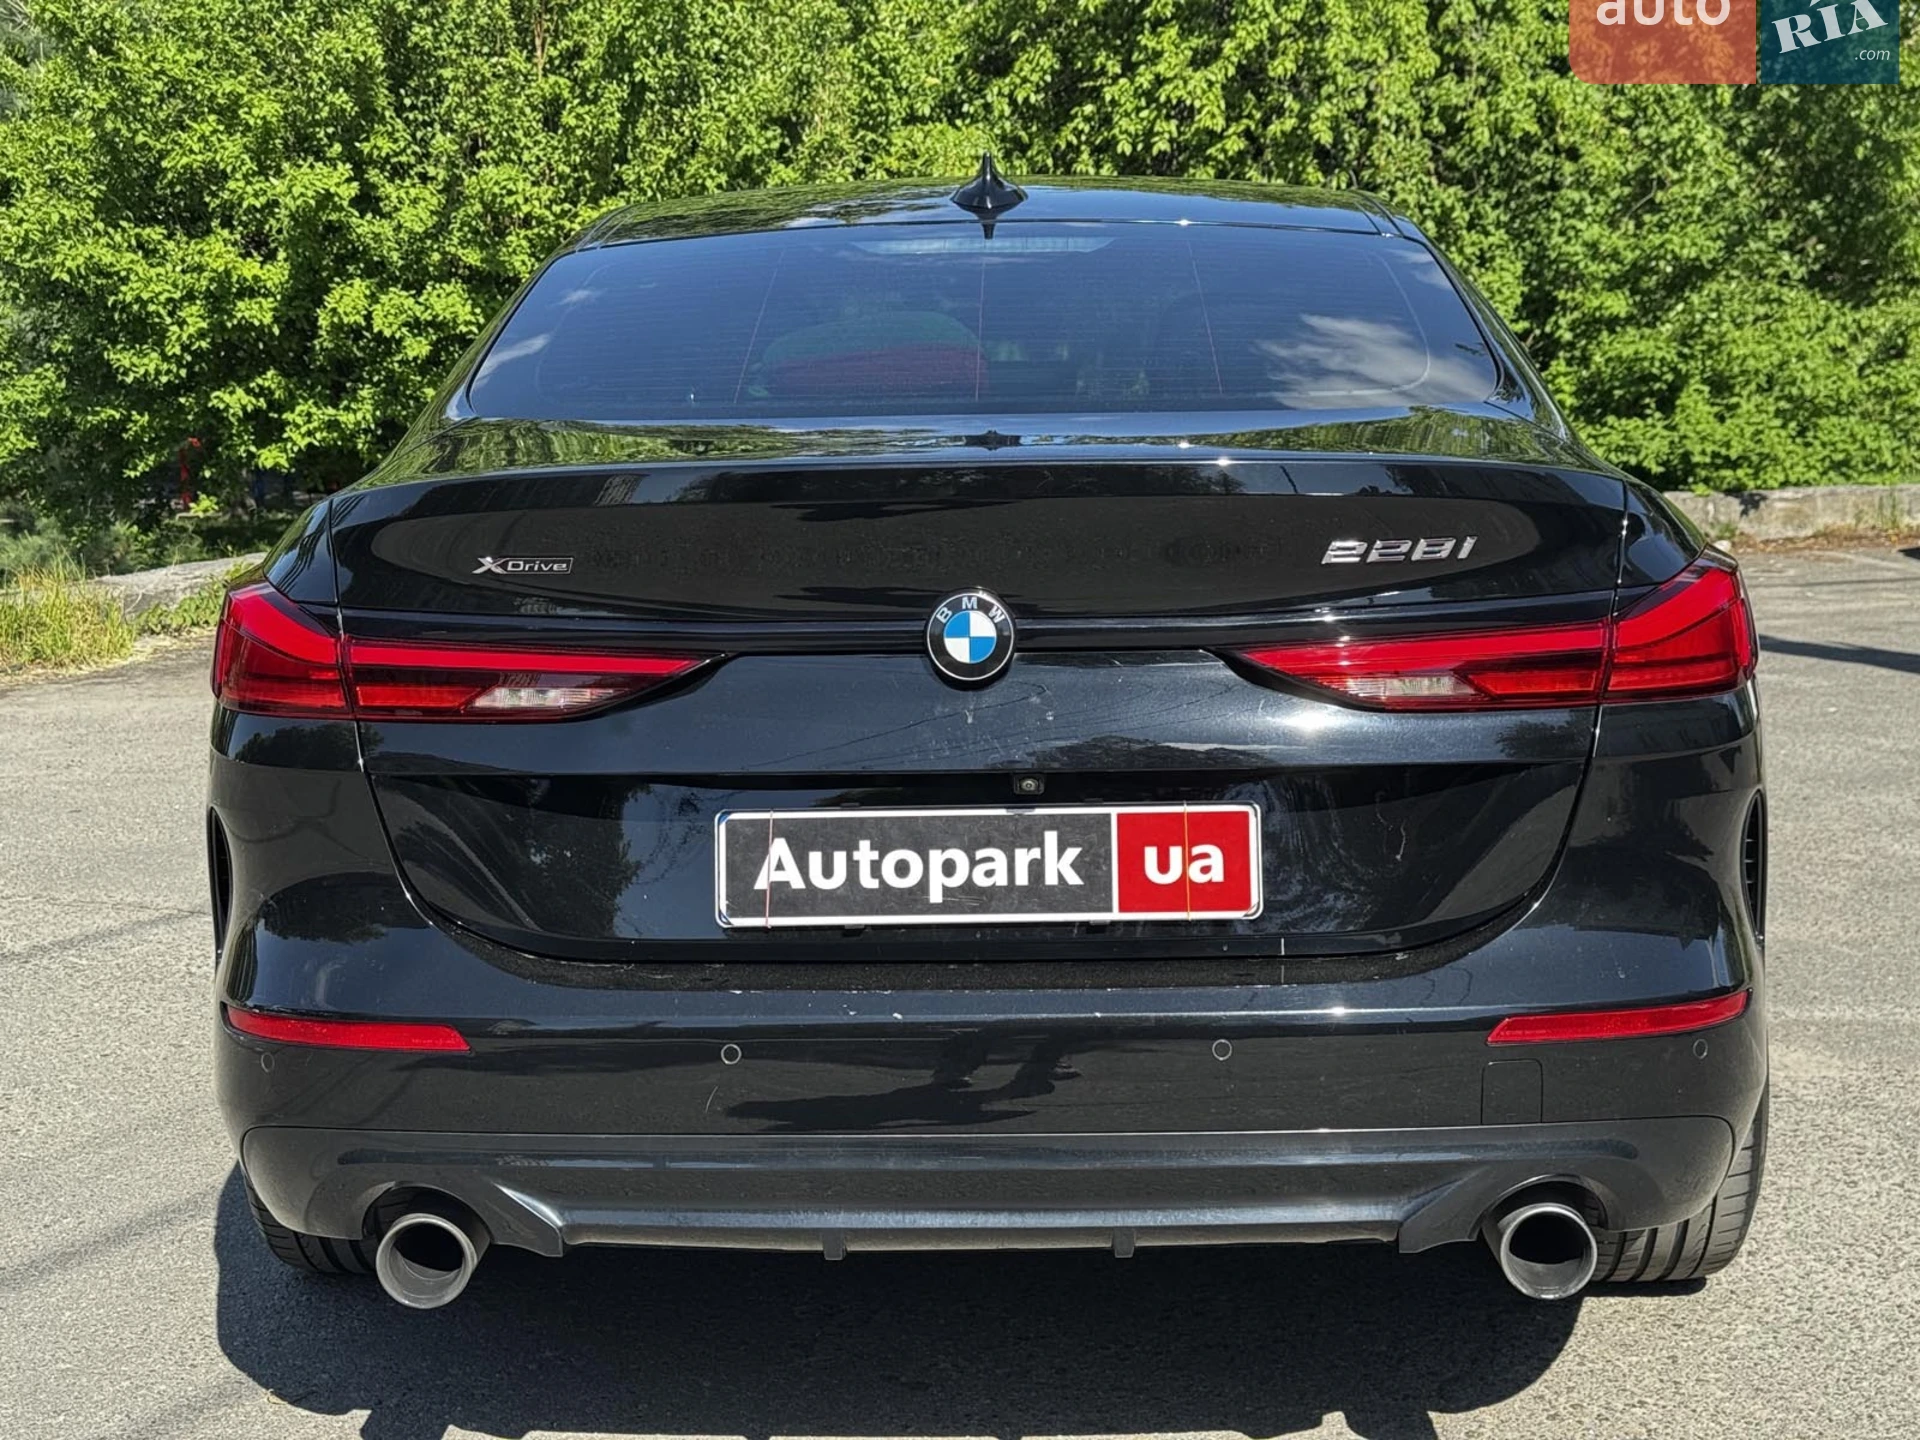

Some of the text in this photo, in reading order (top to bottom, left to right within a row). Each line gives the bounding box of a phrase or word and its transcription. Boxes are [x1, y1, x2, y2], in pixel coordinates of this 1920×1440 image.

[1321, 536, 1478, 565] 228i
[935, 596, 1006, 624] BMW
[753, 830, 1226, 904] Autopark ua
